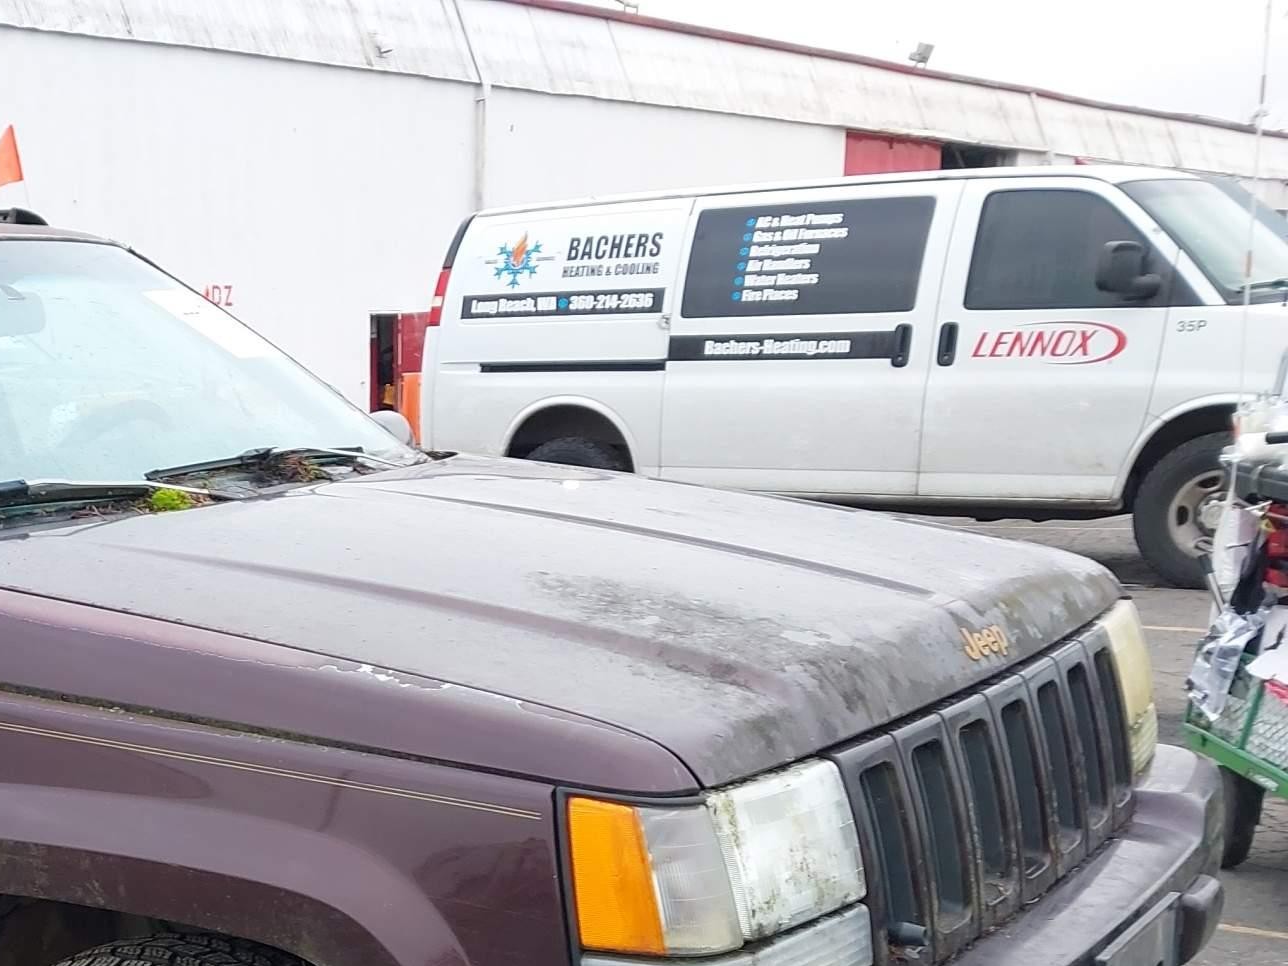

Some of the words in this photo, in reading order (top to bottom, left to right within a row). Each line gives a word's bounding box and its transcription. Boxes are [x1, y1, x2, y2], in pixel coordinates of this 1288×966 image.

[567, 232, 664, 261] BACHERS
[749, 243, 820, 257] Refrigeration
[562, 264, 604, 278] HEATING
[605, 267, 612, 276] &
[614, 262, 660, 276] COOLING
[471, 299, 498, 314] Long
[703, 338, 851, 355] Bachers-Heating.com
[972, 328, 1099, 358] LENNOX
[959, 623, 1009, 661] Jeep
